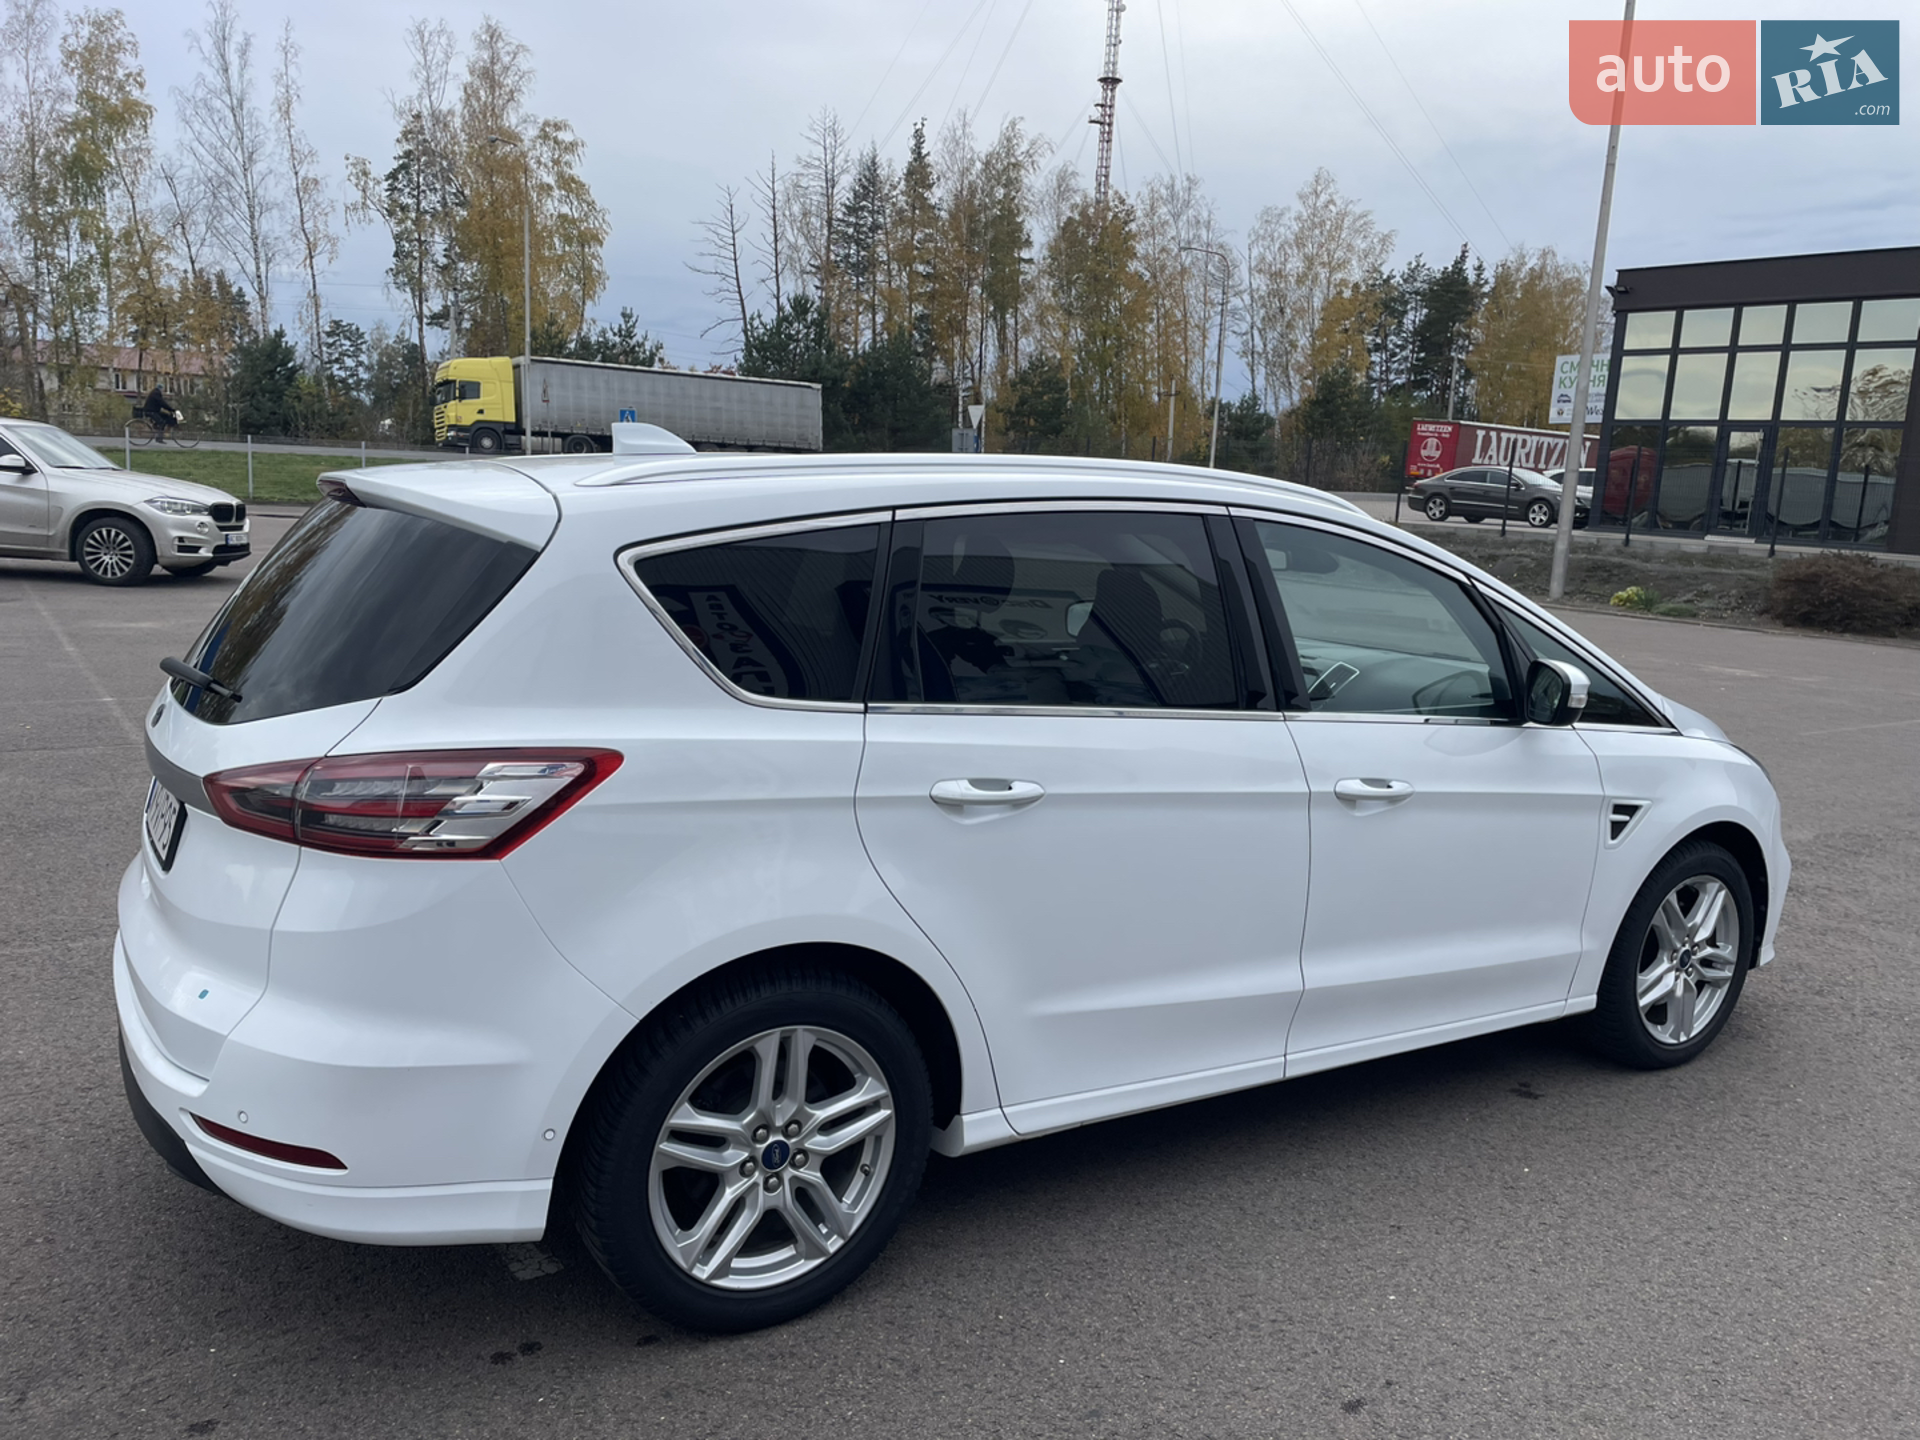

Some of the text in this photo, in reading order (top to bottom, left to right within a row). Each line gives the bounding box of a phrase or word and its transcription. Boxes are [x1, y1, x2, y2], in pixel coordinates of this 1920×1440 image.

[1560, 359, 1611, 375] СМЧН
[1558, 374, 1606, 389] КУНЯ
[1471, 429, 1592, 470] LAURITZN
